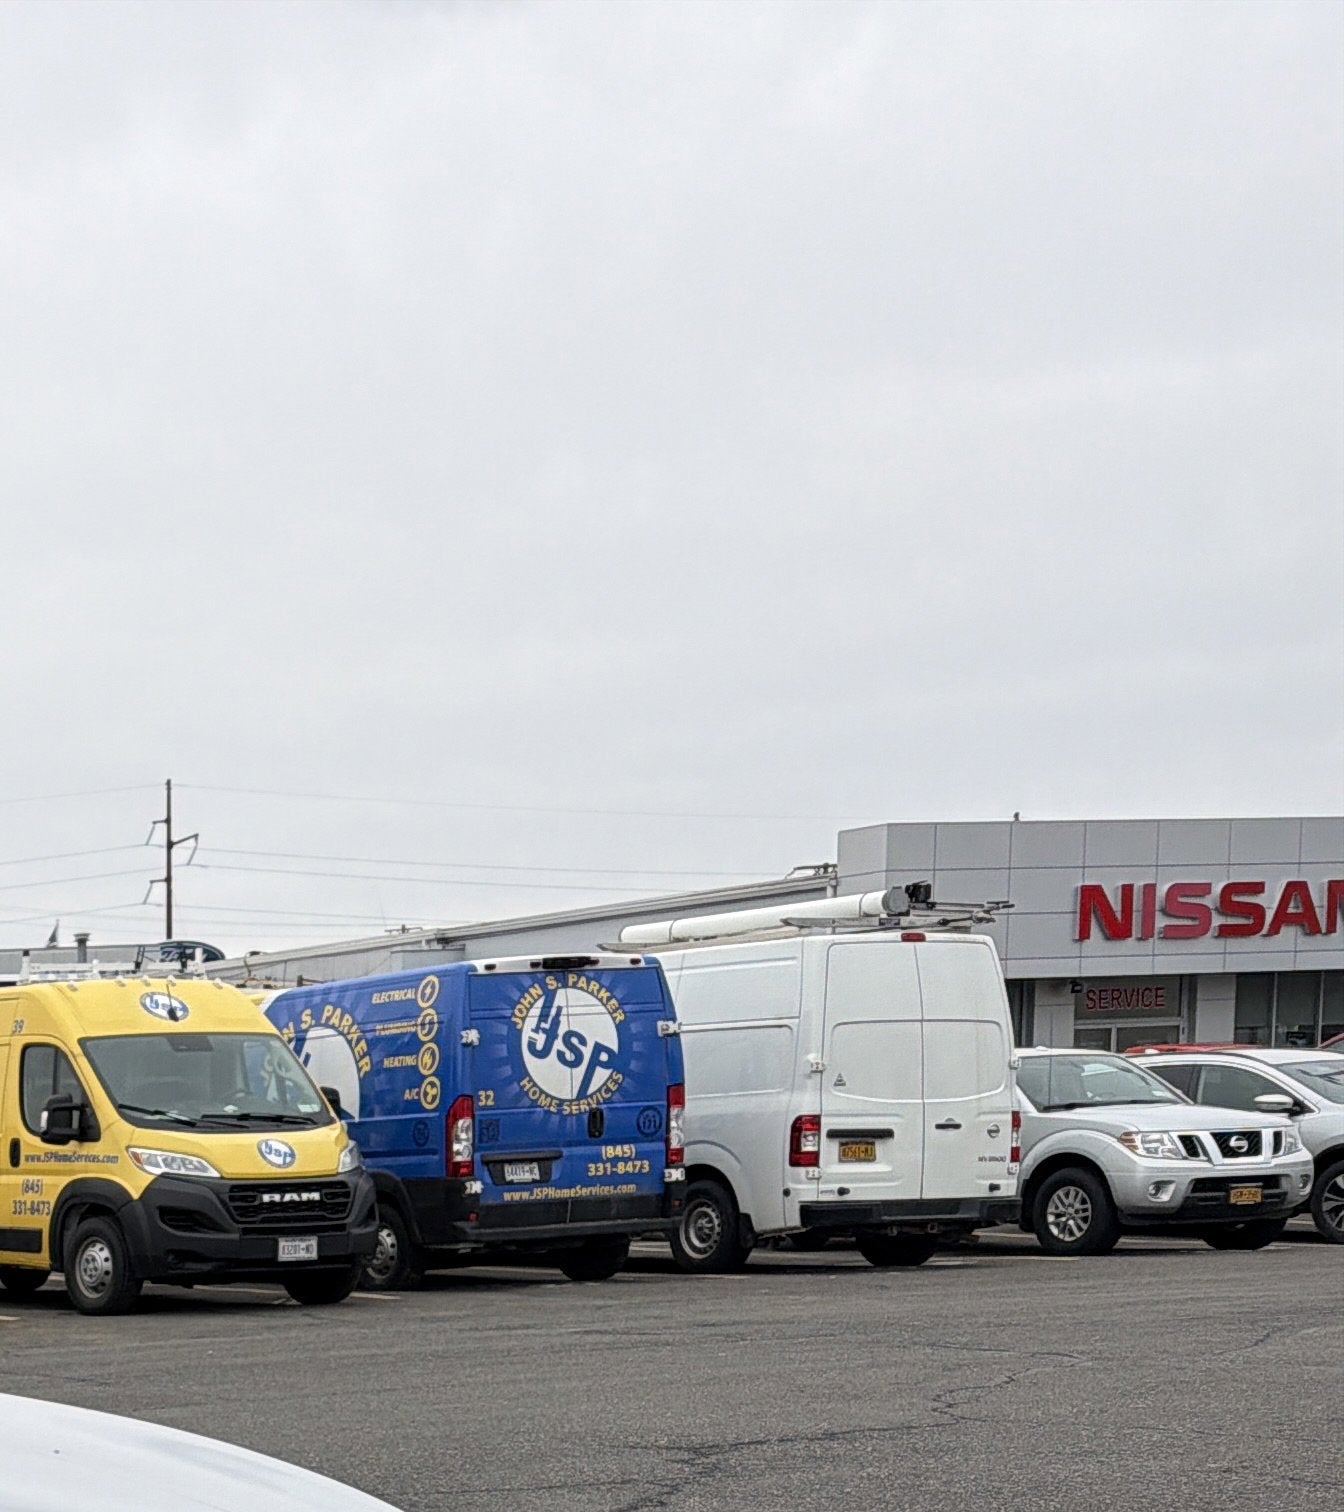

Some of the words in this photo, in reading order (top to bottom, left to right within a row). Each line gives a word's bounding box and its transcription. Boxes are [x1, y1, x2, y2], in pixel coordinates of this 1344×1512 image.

[371, 988, 416, 1004] ELECTRICAL
[511, 983, 544, 1030] JOHN
[545, 975, 562, 990] S.
[567, 973, 625, 1024] PARKER
[1085, 986, 1166, 1011] SERVICE
[12, 1019, 25, 1034] 39
[375, 1021, 417, 1036] PLUMBING
[300, 1007, 316, 1030] S.
[321, 1004, 372, 1079] PARKER
[526, 990, 621, 1100] JSP
[383, 1055, 417, 1068] HEATING
[404, 1087, 420, 1101] A/C
[478, 1090, 495, 1106] 32
[519, 1076, 559, 1113] HOME
[562, 1070, 624, 1115] SERVICES
[601, 1143, 636, 1160] (845)
[587, 1160, 651, 1177] 331-8473
[22, 1179, 44, 1196] (845)
[502, 1183, 637, 1202] www.JSPHomeServices.com
[262, 1191, 321, 1203] RAM
[12, 1199, 52, 1216] 331-8473
